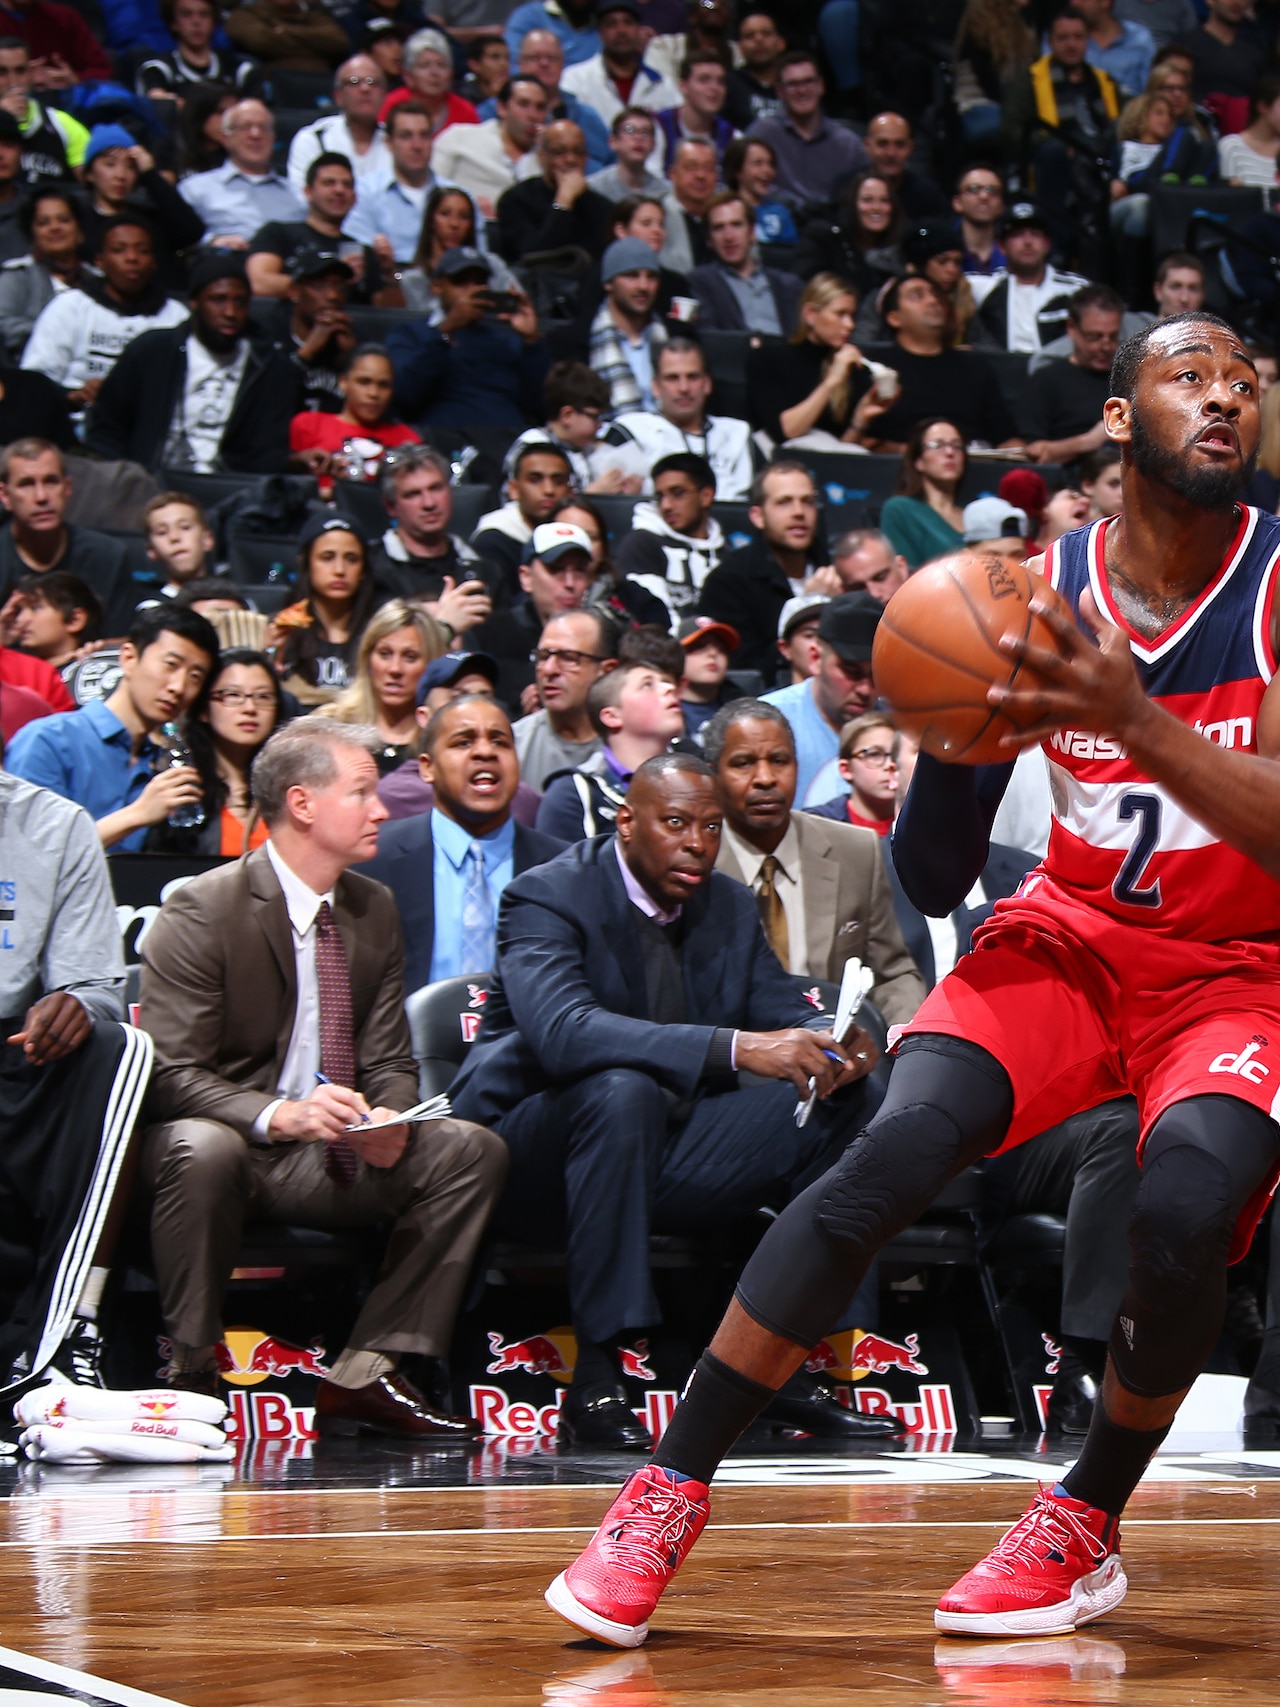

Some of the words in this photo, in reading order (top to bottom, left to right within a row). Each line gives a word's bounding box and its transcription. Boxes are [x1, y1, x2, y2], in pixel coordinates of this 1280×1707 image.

[1111, 791, 1163, 909] 2
[1208, 1041, 1271, 1085] dc
[130, 1421, 154, 1435] Red
[155, 1422, 178, 1437] Bull
